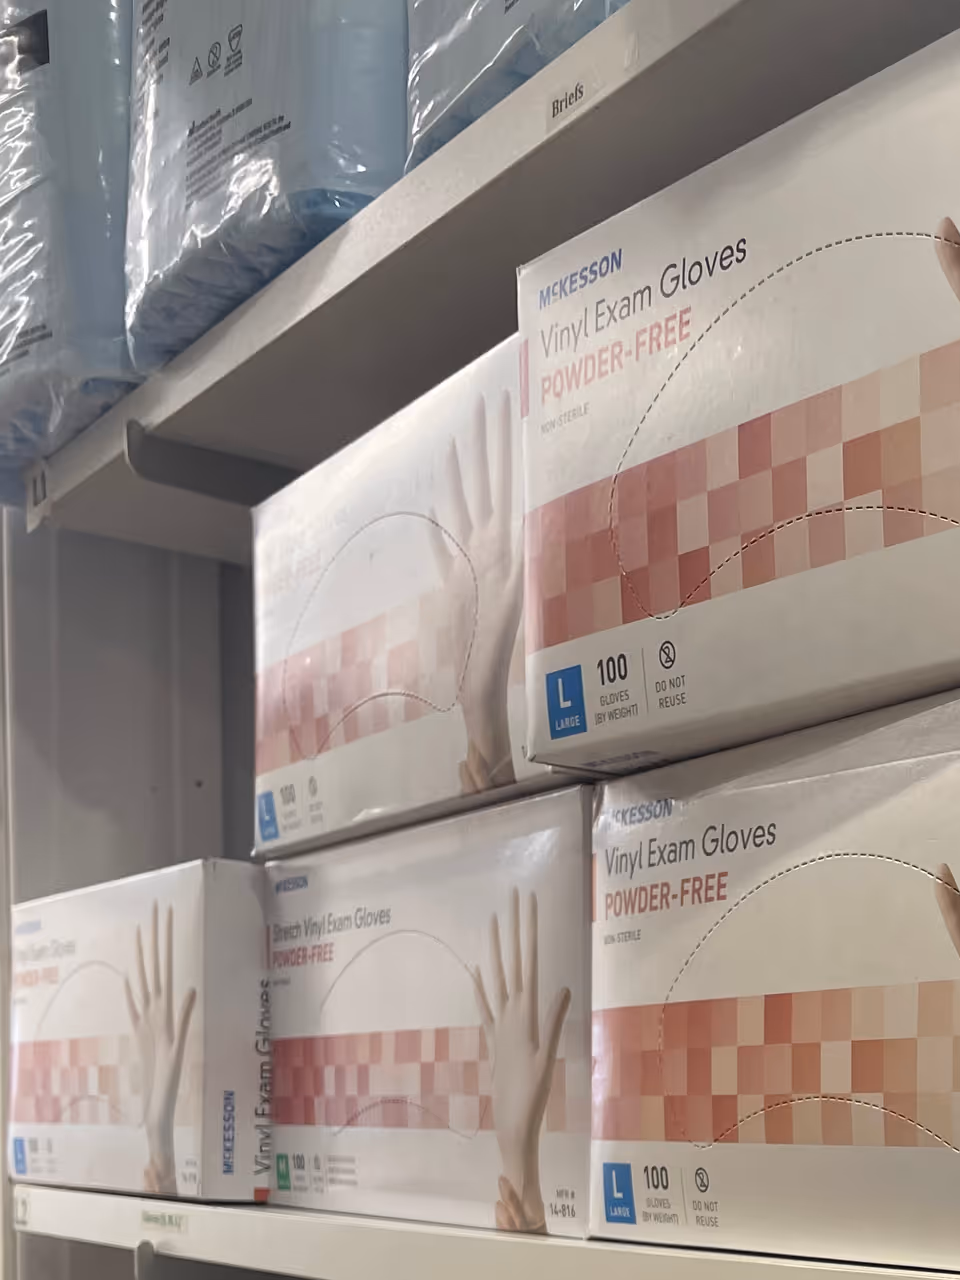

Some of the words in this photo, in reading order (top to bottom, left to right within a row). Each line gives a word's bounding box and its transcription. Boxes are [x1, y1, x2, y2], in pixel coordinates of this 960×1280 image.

[552, 82, 584, 118] Briefs
[541, 305, 588, 358] Vinyl
[595, 284, 651, 332] Exam
[659, 237, 747, 298] Gloves
[541, 306, 692, 405] POWDER-FREE
[596, 653, 628, 686] 100
[558, 678, 571, 709] L
[599, 689, 630, 707] GLOVES
[658, 692, 687, 709] REUSE
[555, 715, 580, 731] LARGE
[605, 841, 643, 879] Vinyl
[647, 838, 695, 868] Exam
[701, 822, 777, 857] Gloves
[605, 871, 729, 921] POWDER-FREE
[327, 912, 353, 935] Exam
[354, 906, 391, 930] Gloves
[612, 1169, 624, 1199] L
[643, 1165, 669, 1190] 100
